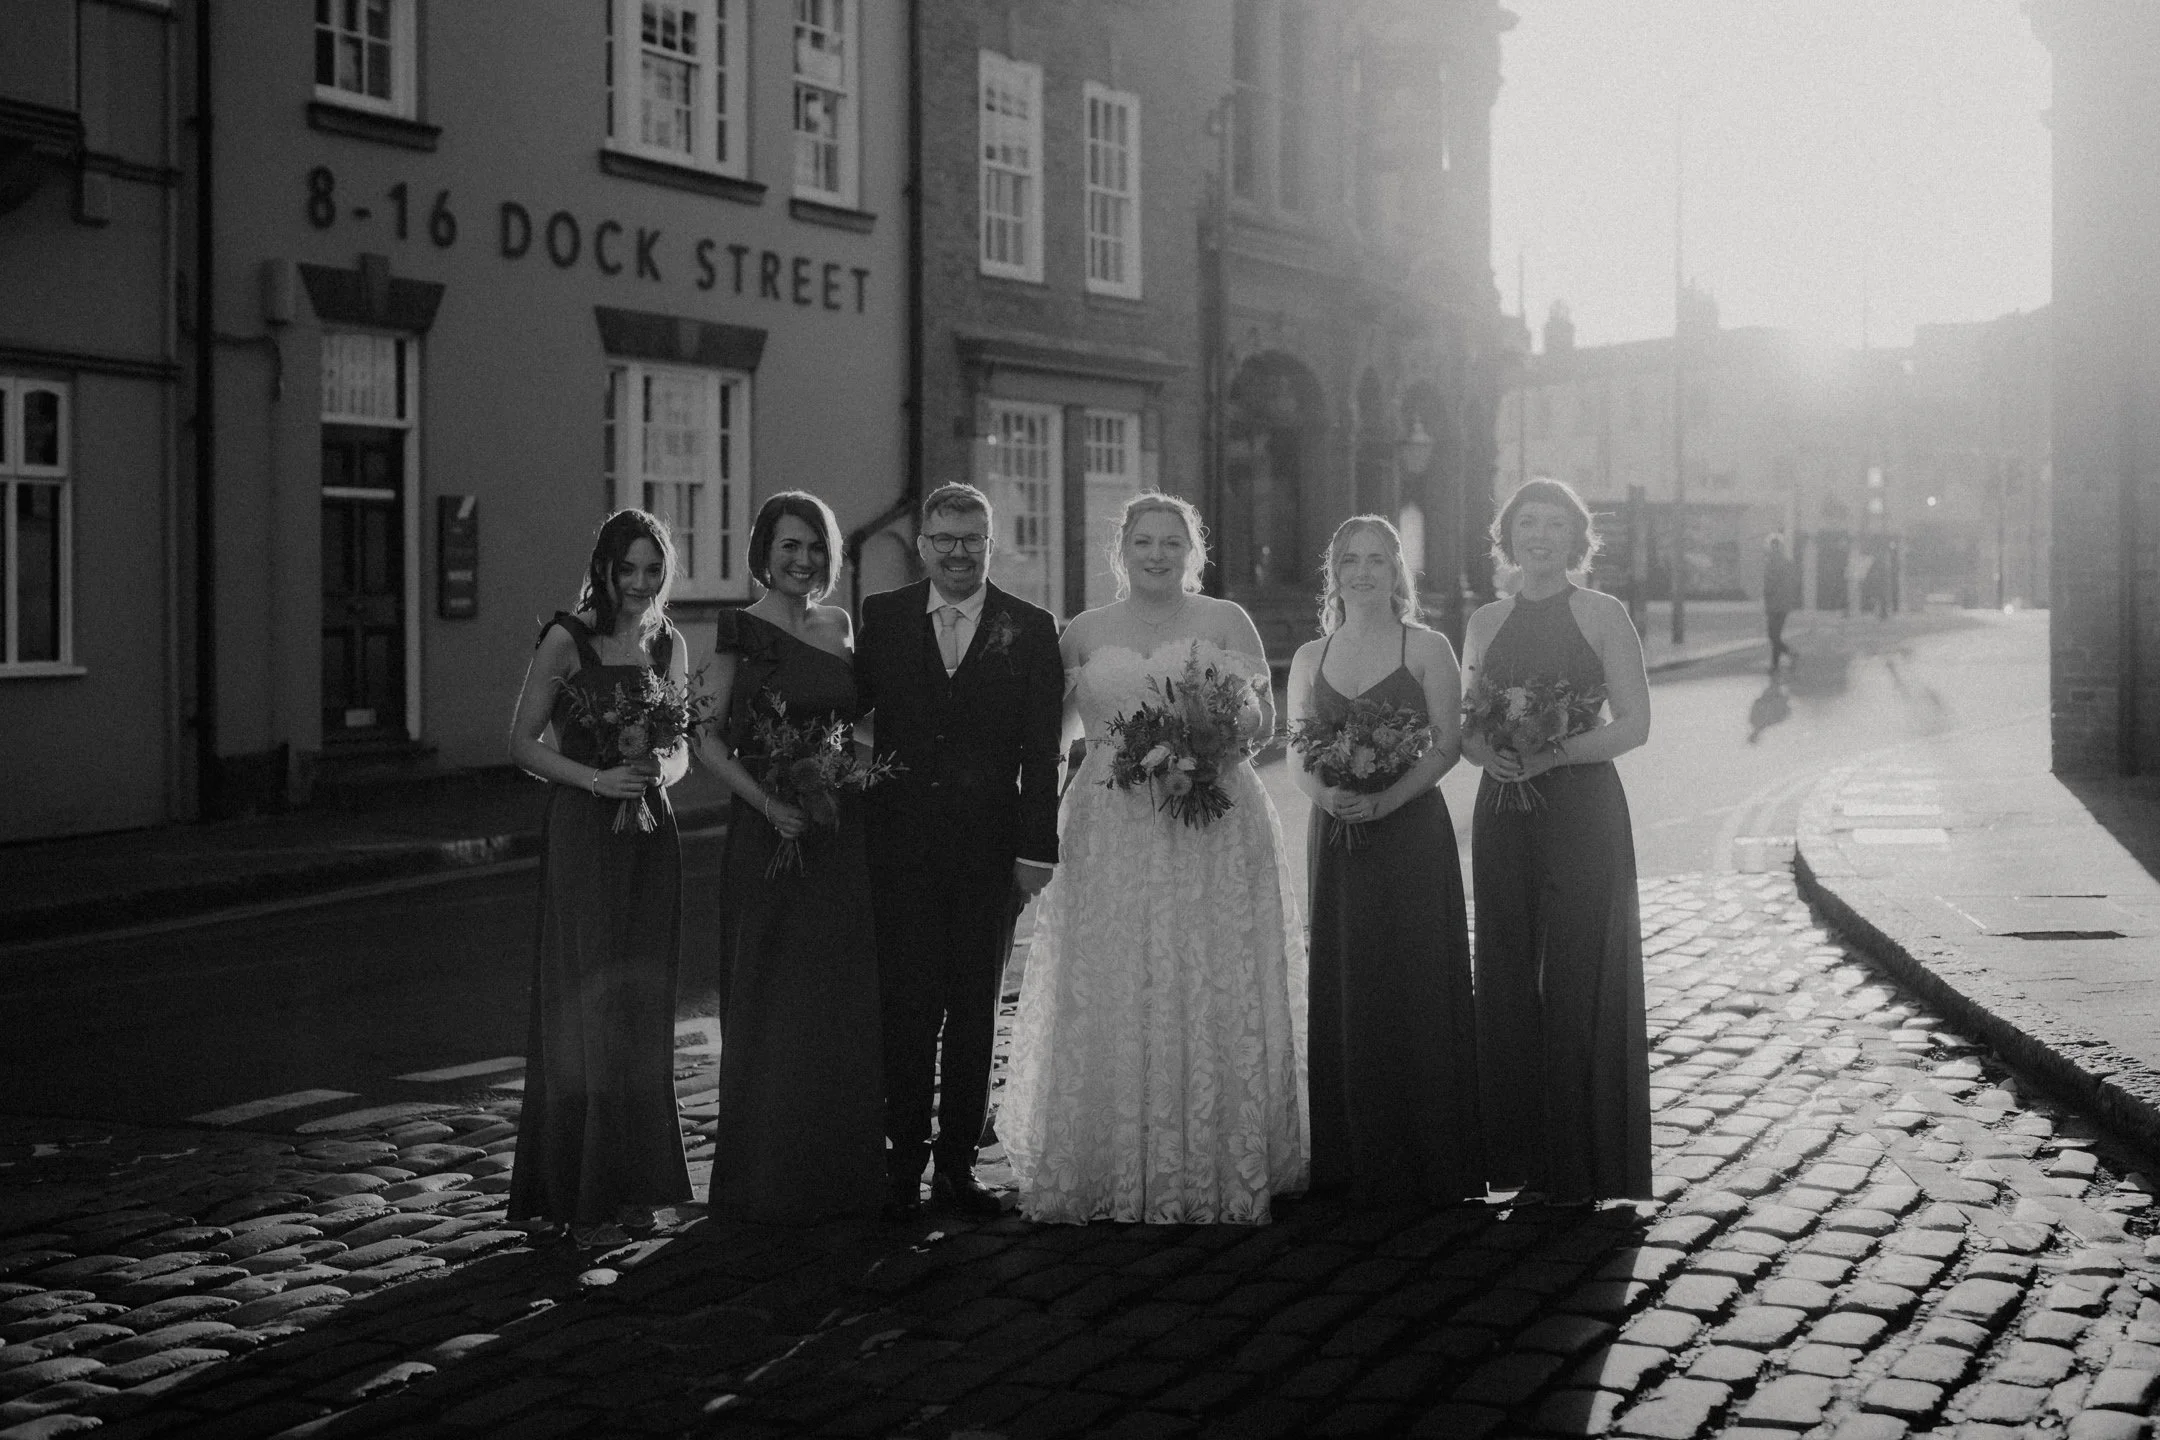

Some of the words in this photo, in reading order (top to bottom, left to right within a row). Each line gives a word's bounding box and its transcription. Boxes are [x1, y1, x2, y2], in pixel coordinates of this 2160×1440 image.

[306, 166, 457, 248] 8-16
[501, 202, 662, 282] DOCK
[696, 239, 871, 314] STREET
